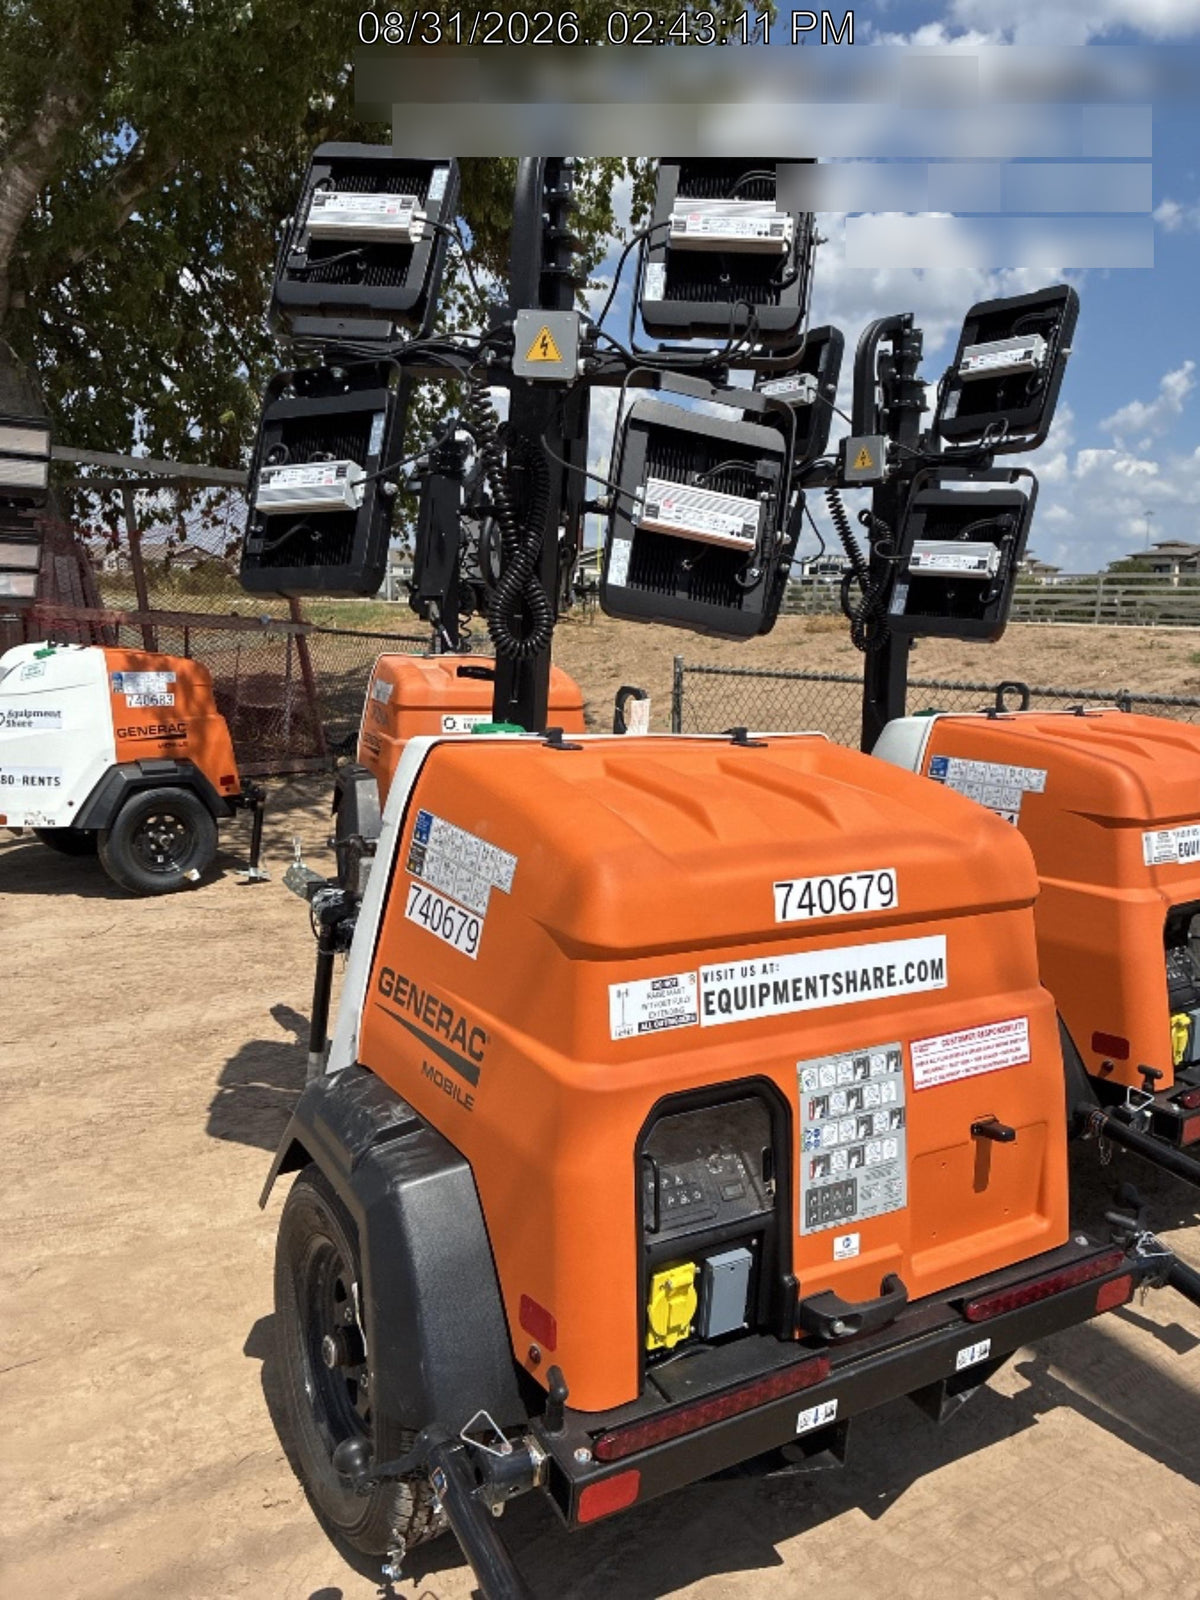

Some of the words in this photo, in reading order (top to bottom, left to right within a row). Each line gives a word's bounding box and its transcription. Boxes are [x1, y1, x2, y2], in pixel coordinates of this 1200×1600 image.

[6, 709, 62, 720] Equipment
[116, 723, 187, 738] GENERAC
[407, 884, 481, 955] 740679
[774, 872, 895, 920] 740679
[702, 968, 735, 984] VISIT
[741, 964, 757, 979] US
[762, 962, 780, 975] AT:
[703, 957, 945, 1016] EQUIPMENTSHARE.COM
[378, 966, 487, 1063] GENERAC
[421, 1060, 475, 1113] MOBILE
